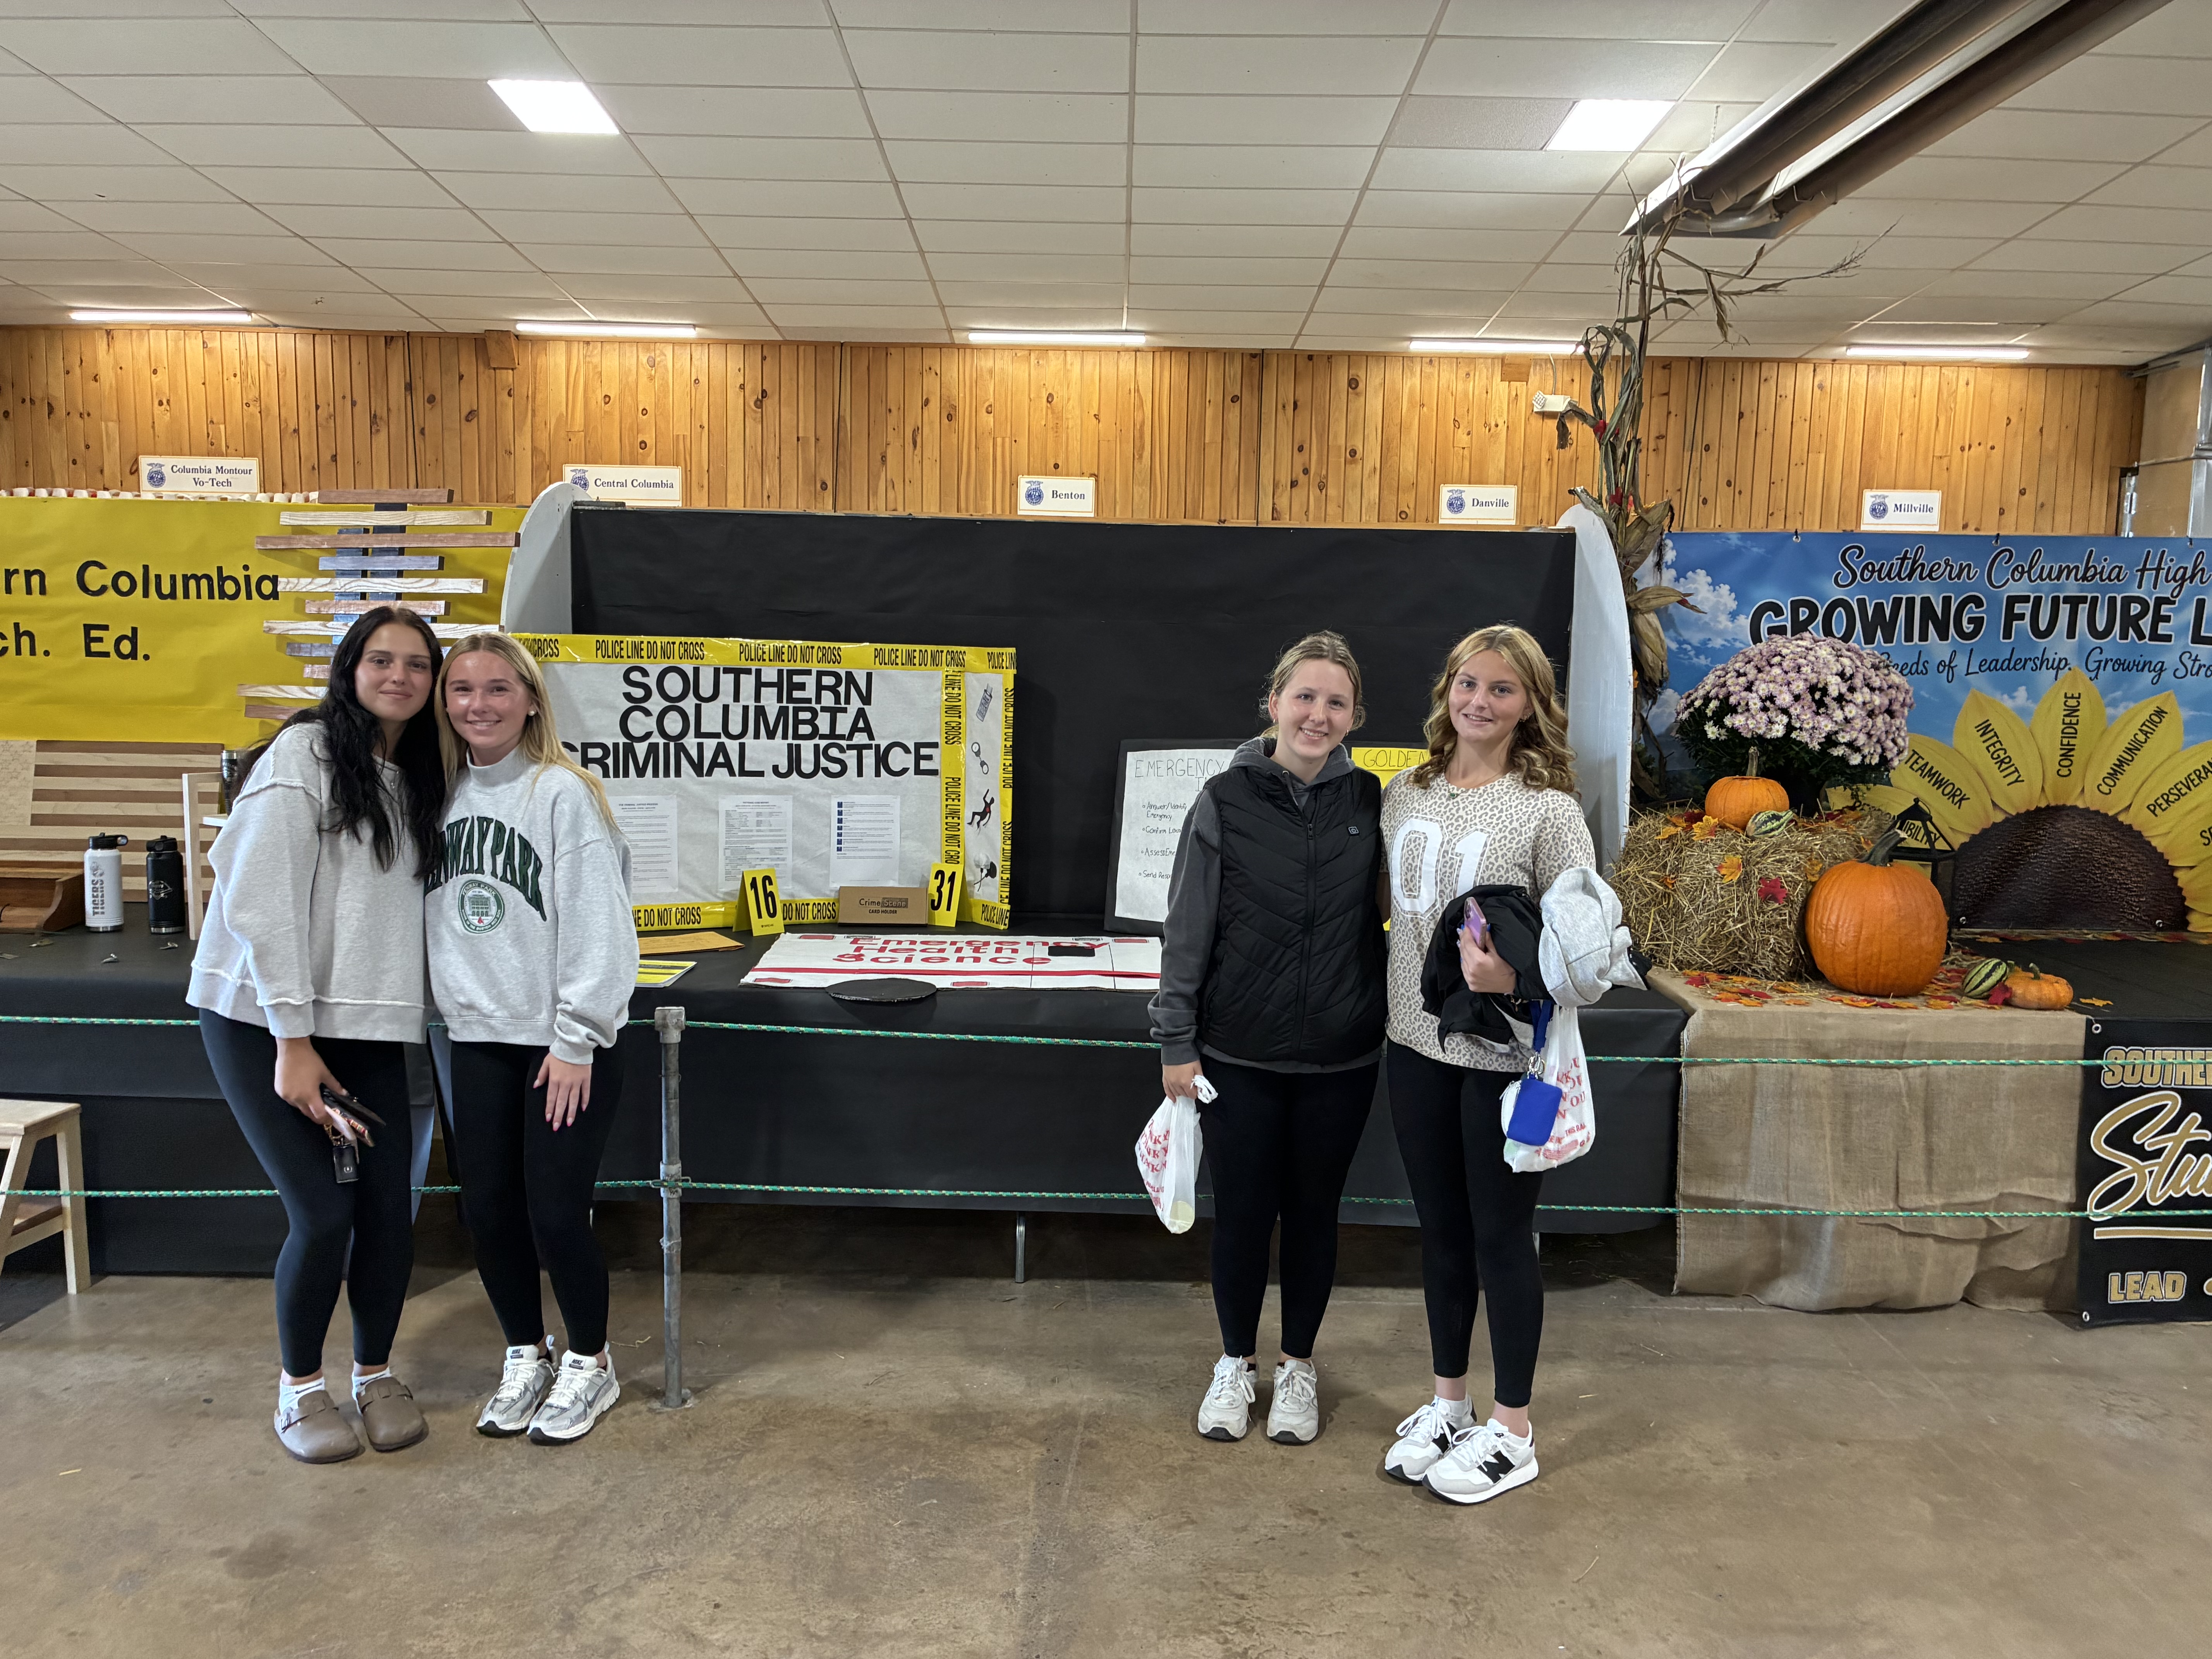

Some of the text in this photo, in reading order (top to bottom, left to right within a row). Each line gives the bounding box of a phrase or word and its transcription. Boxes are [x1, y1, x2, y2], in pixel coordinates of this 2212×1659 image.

[171, 464, 252, 475] Columbia Montour
[193, 477, 232, 487] Vo-Tech
[594, 478, 674, 489] Central Columbia
[1051, 490, 1085, 500] Benton
[1472, 498, 1509, 507] Danville
[1893, 503, 1934, 513] Millville
[77, 560, 279, 601] Columbia
[1833, 544, 2212, 599] Southern Columbia High
[1749, 592, 1986, 647] GROWING
[2000, 592, 2178, 644] FUTURE
[83, 623, 150, 661] Ed.
[533, 638, 559, 658] CROSS
[596, 639, 705, 661] POLICE LINE DO NOT CROSS
[739, 643, 842, 665] POLICE LINE DO NOT CROSS
[874, 648, 966, 668] POLICE LINE DO NOT CROSS
[987, 652, 1004, 670] POLICE
[1937, 649, 1958, 683] of
[1966, 646, 2072, 682] Leadership.
[2085, 646, 2167, 685] Growing
[622, 665, 873, 706] SOUTHERN
[945, 675, 962, 745] LINE DO NOT CROSS
[620, 704, 875, 743] COLUMBIA
[2056, 692, 2081, 778] CONFIDENCE
[772, 741, 939, 779] JUSTICE
[1975, 719, 2025, 787] INTEGRITY
[2097, 706, 2168, 796] COMMUNICATION
[1135, 758, 1225, 778] EMERGENCY
[944, 777, 961, 802] POLICE
[1904, 749, 1971, 809] TEAMWORK
[944, 804, 961, 820] LINE
[1147, 811, 1172, 821] Emergency
[945, 821, 961, 832] DO
[1146, 826, 1166, 834] Confirm
[945, 833, 961, 848] NOT
[1144, 847, 1165, 857] Assess
[490, 819, 547, 922] PARK
[1143, 870, 1157, 878] Send
[1391, 814, 1495, 920] 01
[91, 878, 105, 917] TIGERS
[481, 884, 496, 896] PARK
[750, 875, 777, 920] 16
[930, 870, 957, 912] 31
[783, 902, 836, 922] DO NOT CROSS
[859, 898, 906, 908] Crime Scene
[644, 906, 655, 927] DO
[657, 907, 673, 926] NOT
[675, 906, 701, 926] CROSS
[981, 903, 1010, 926] POLICE LINE
[850, 938, 1110, 949] Emergency
[853, 946, 1019, 955] Health
[833, 953, 1052, 965] Science
[2108, 1271, 2187, 1304] LEAD
